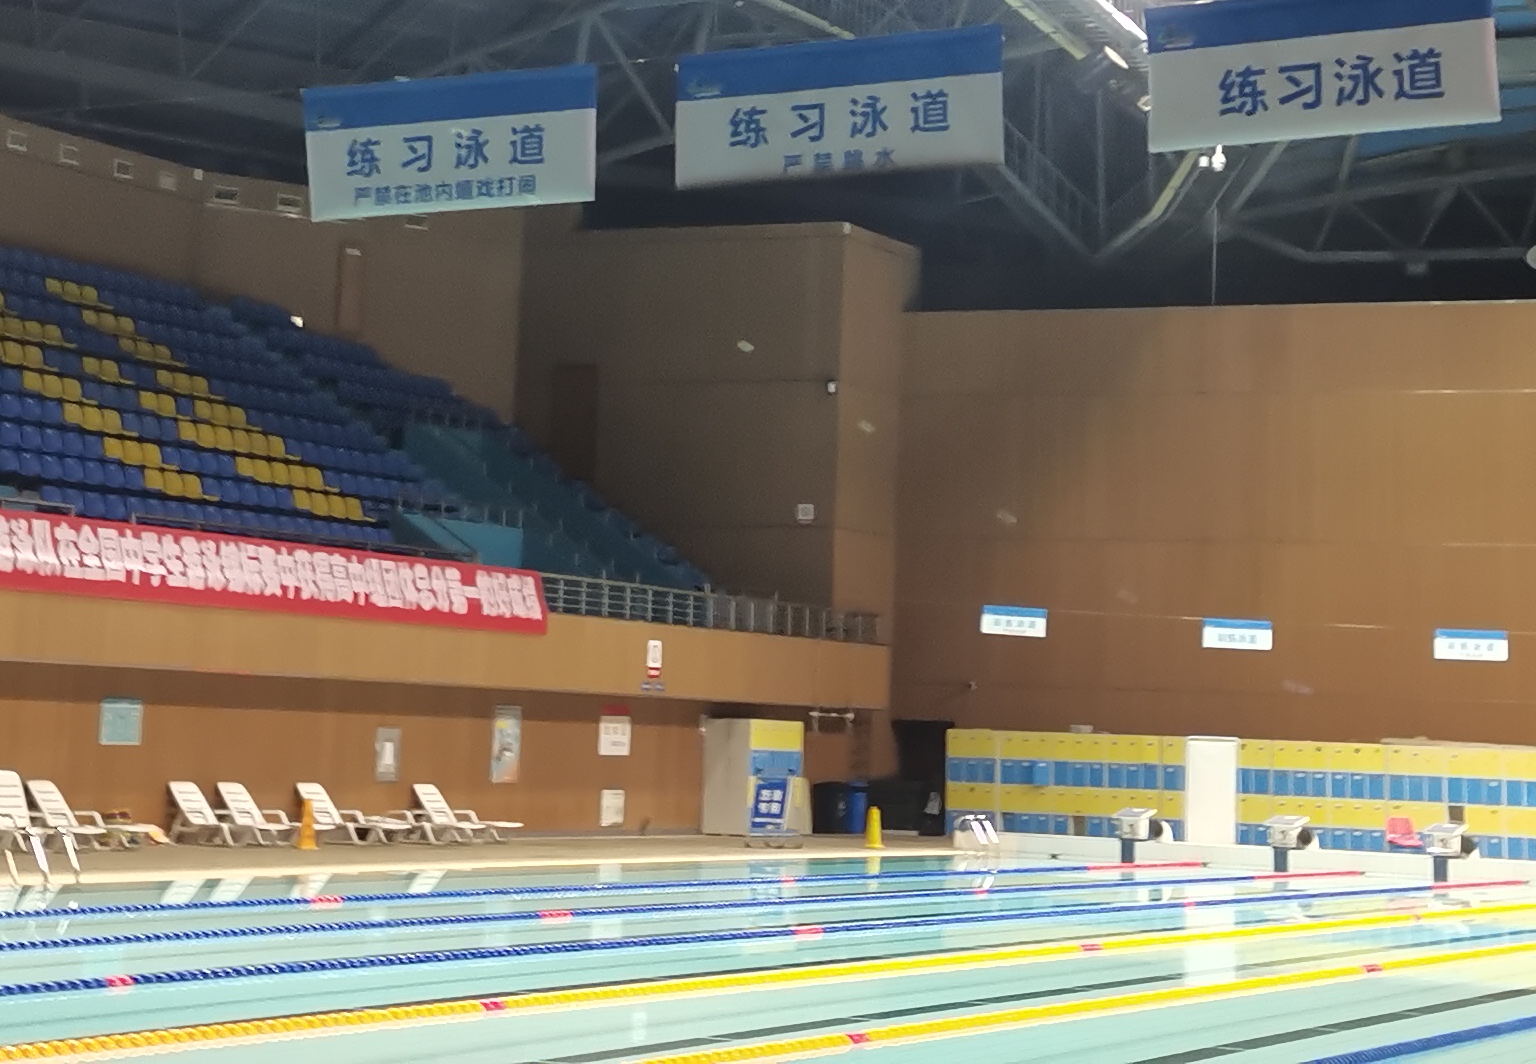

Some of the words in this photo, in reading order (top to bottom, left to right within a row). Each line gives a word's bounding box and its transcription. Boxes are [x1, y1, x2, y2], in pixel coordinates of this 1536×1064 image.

[1219, 47, 1446, 117] 练习泳道
[728, 89, 951, 149] 练习泳道
[346, 124, 546, 178] 练习泳道
